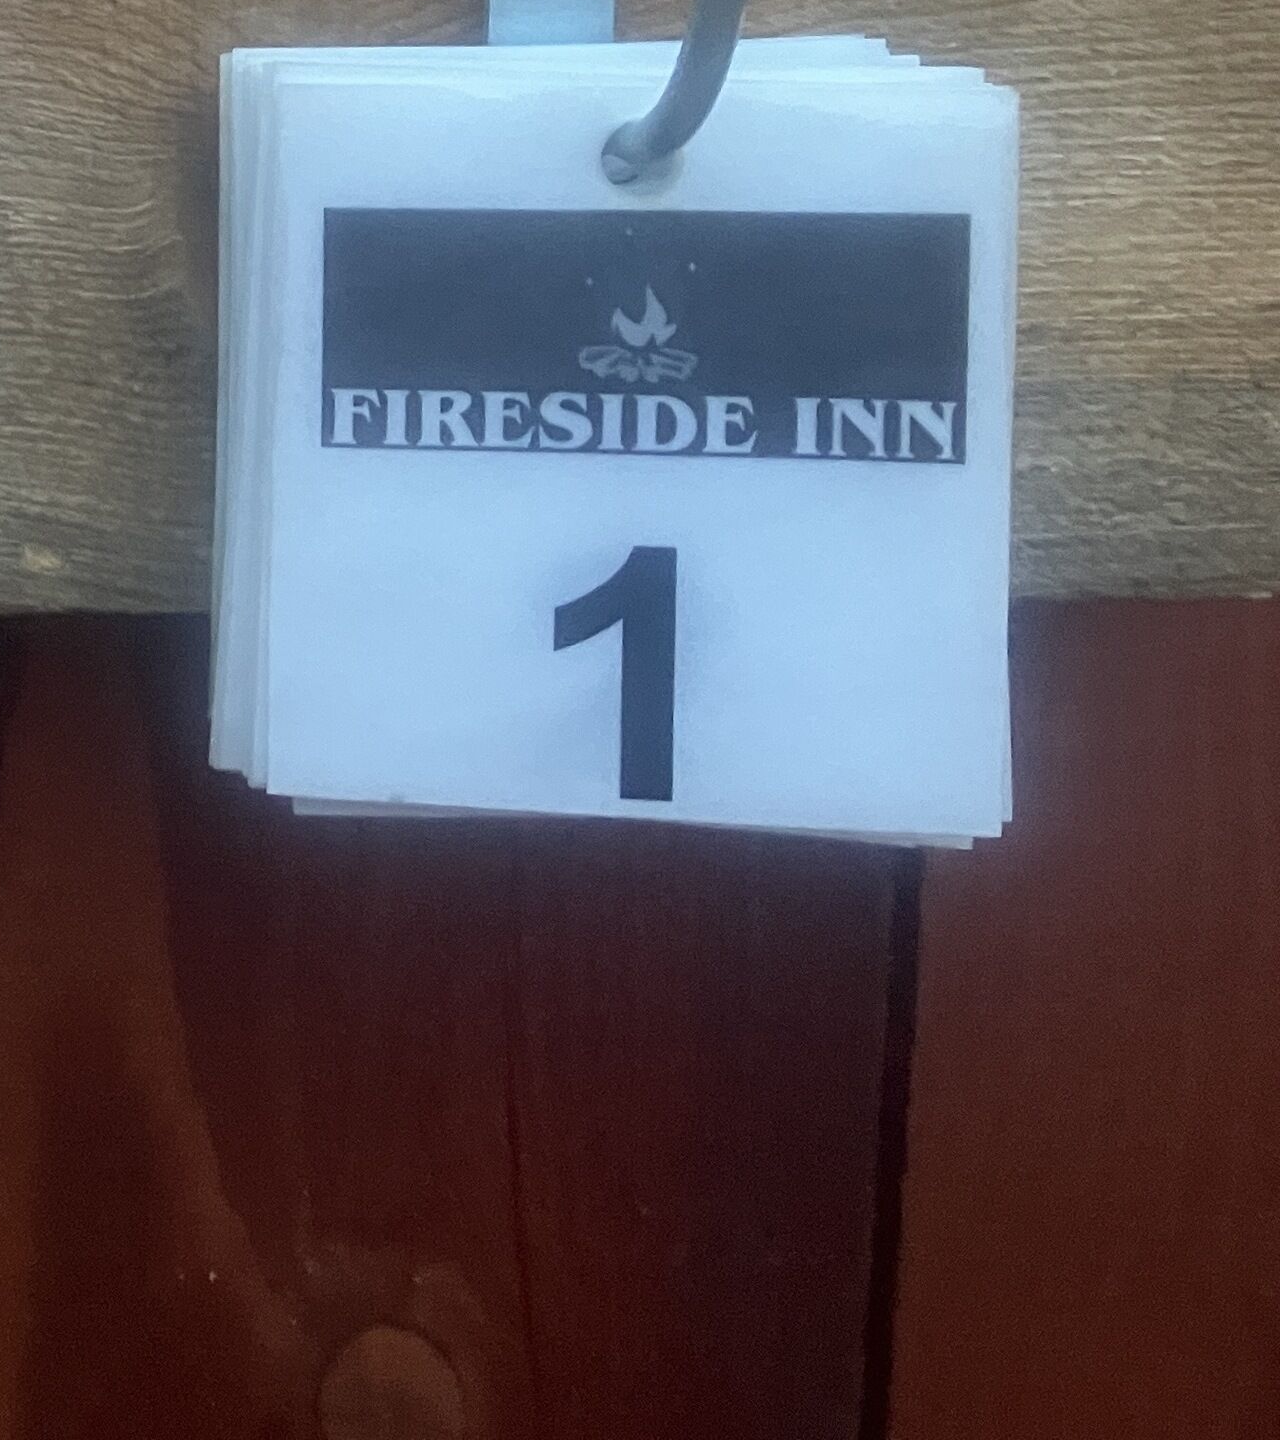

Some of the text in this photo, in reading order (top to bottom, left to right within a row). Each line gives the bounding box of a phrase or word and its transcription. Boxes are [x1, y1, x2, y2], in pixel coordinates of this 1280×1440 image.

[330, 388, 958, 460] FIRESIDE INN
[554, 546, 677, 801] 1
